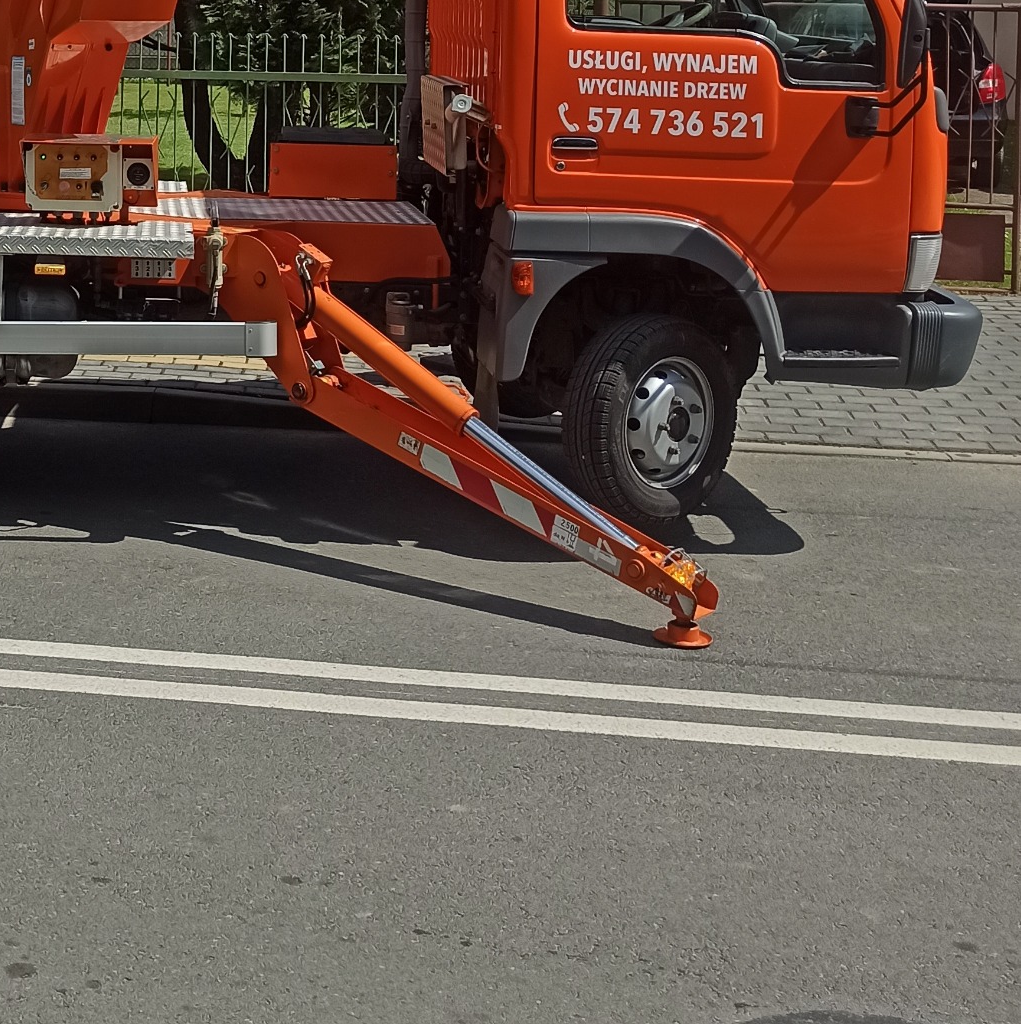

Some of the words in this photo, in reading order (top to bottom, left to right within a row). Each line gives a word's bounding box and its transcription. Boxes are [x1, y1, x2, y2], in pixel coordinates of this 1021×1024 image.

[568, 49, 648, 74] USŁUGI,
[652, 52, 758, 75] WYNAJEM
[578, 78, 679, 98] WYCINANIE
[683, 81, 747, 100] DRZEW
[586, 106, 641, 134] 574
[650, 109, 704, 137] 736
[712, 111, 764, 139] 521
[560, 518, 579, 534] 2500
